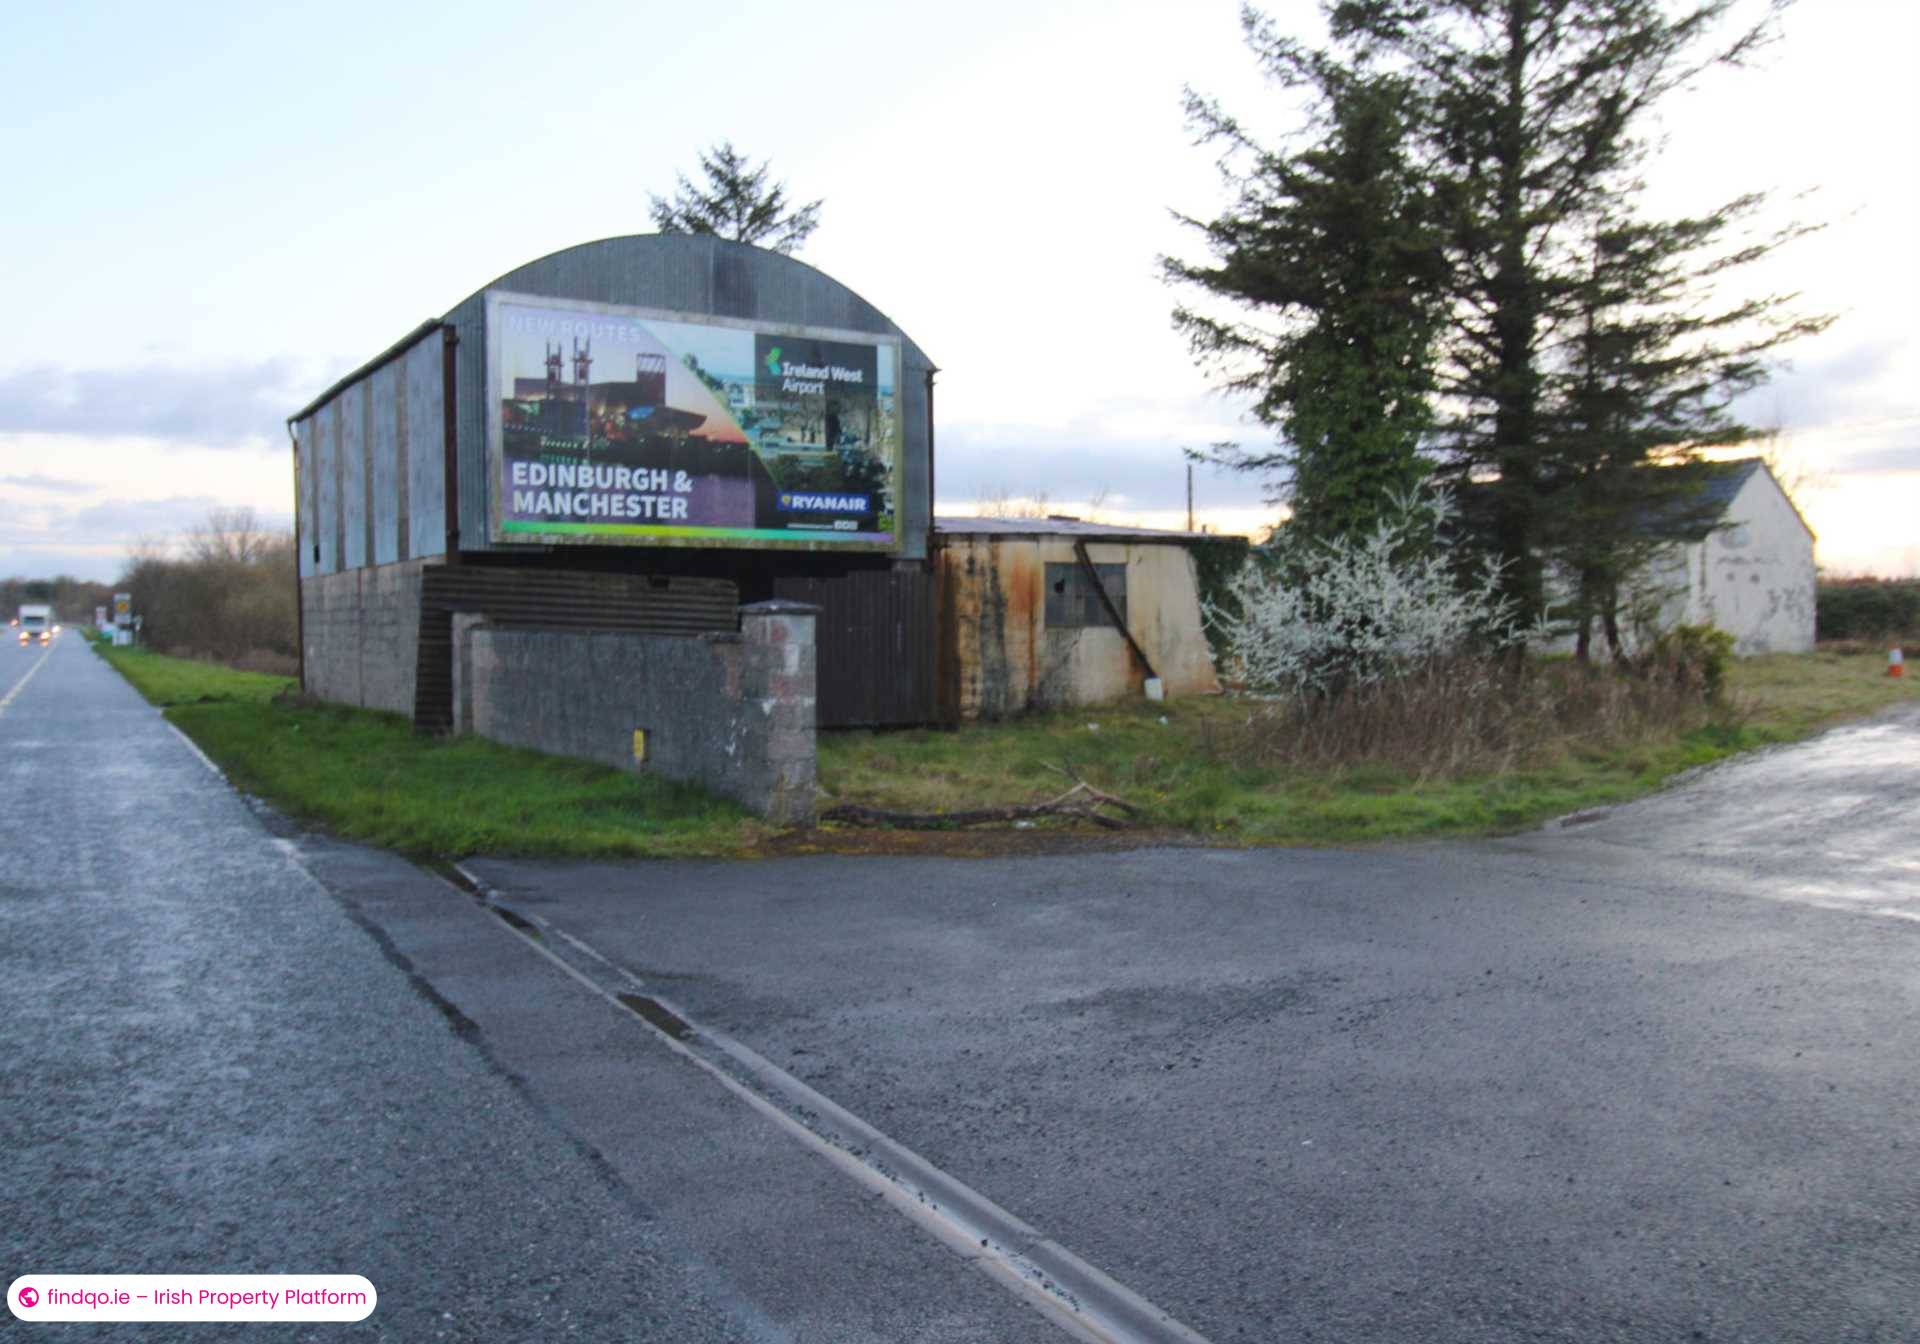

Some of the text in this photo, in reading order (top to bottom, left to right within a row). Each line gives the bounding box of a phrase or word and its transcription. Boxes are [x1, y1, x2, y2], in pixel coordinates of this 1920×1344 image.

[510, 315, 641, 343] NEW ROUTES
[782, 362, 863, 383] Ireland West
[782, 377, 825, 394] Airport
[512, 461, 692, 493] EDINBURGH &
[512, 491, 688, 519] MANCHESTER
[792, 495, 867, 511] RYANAIR
